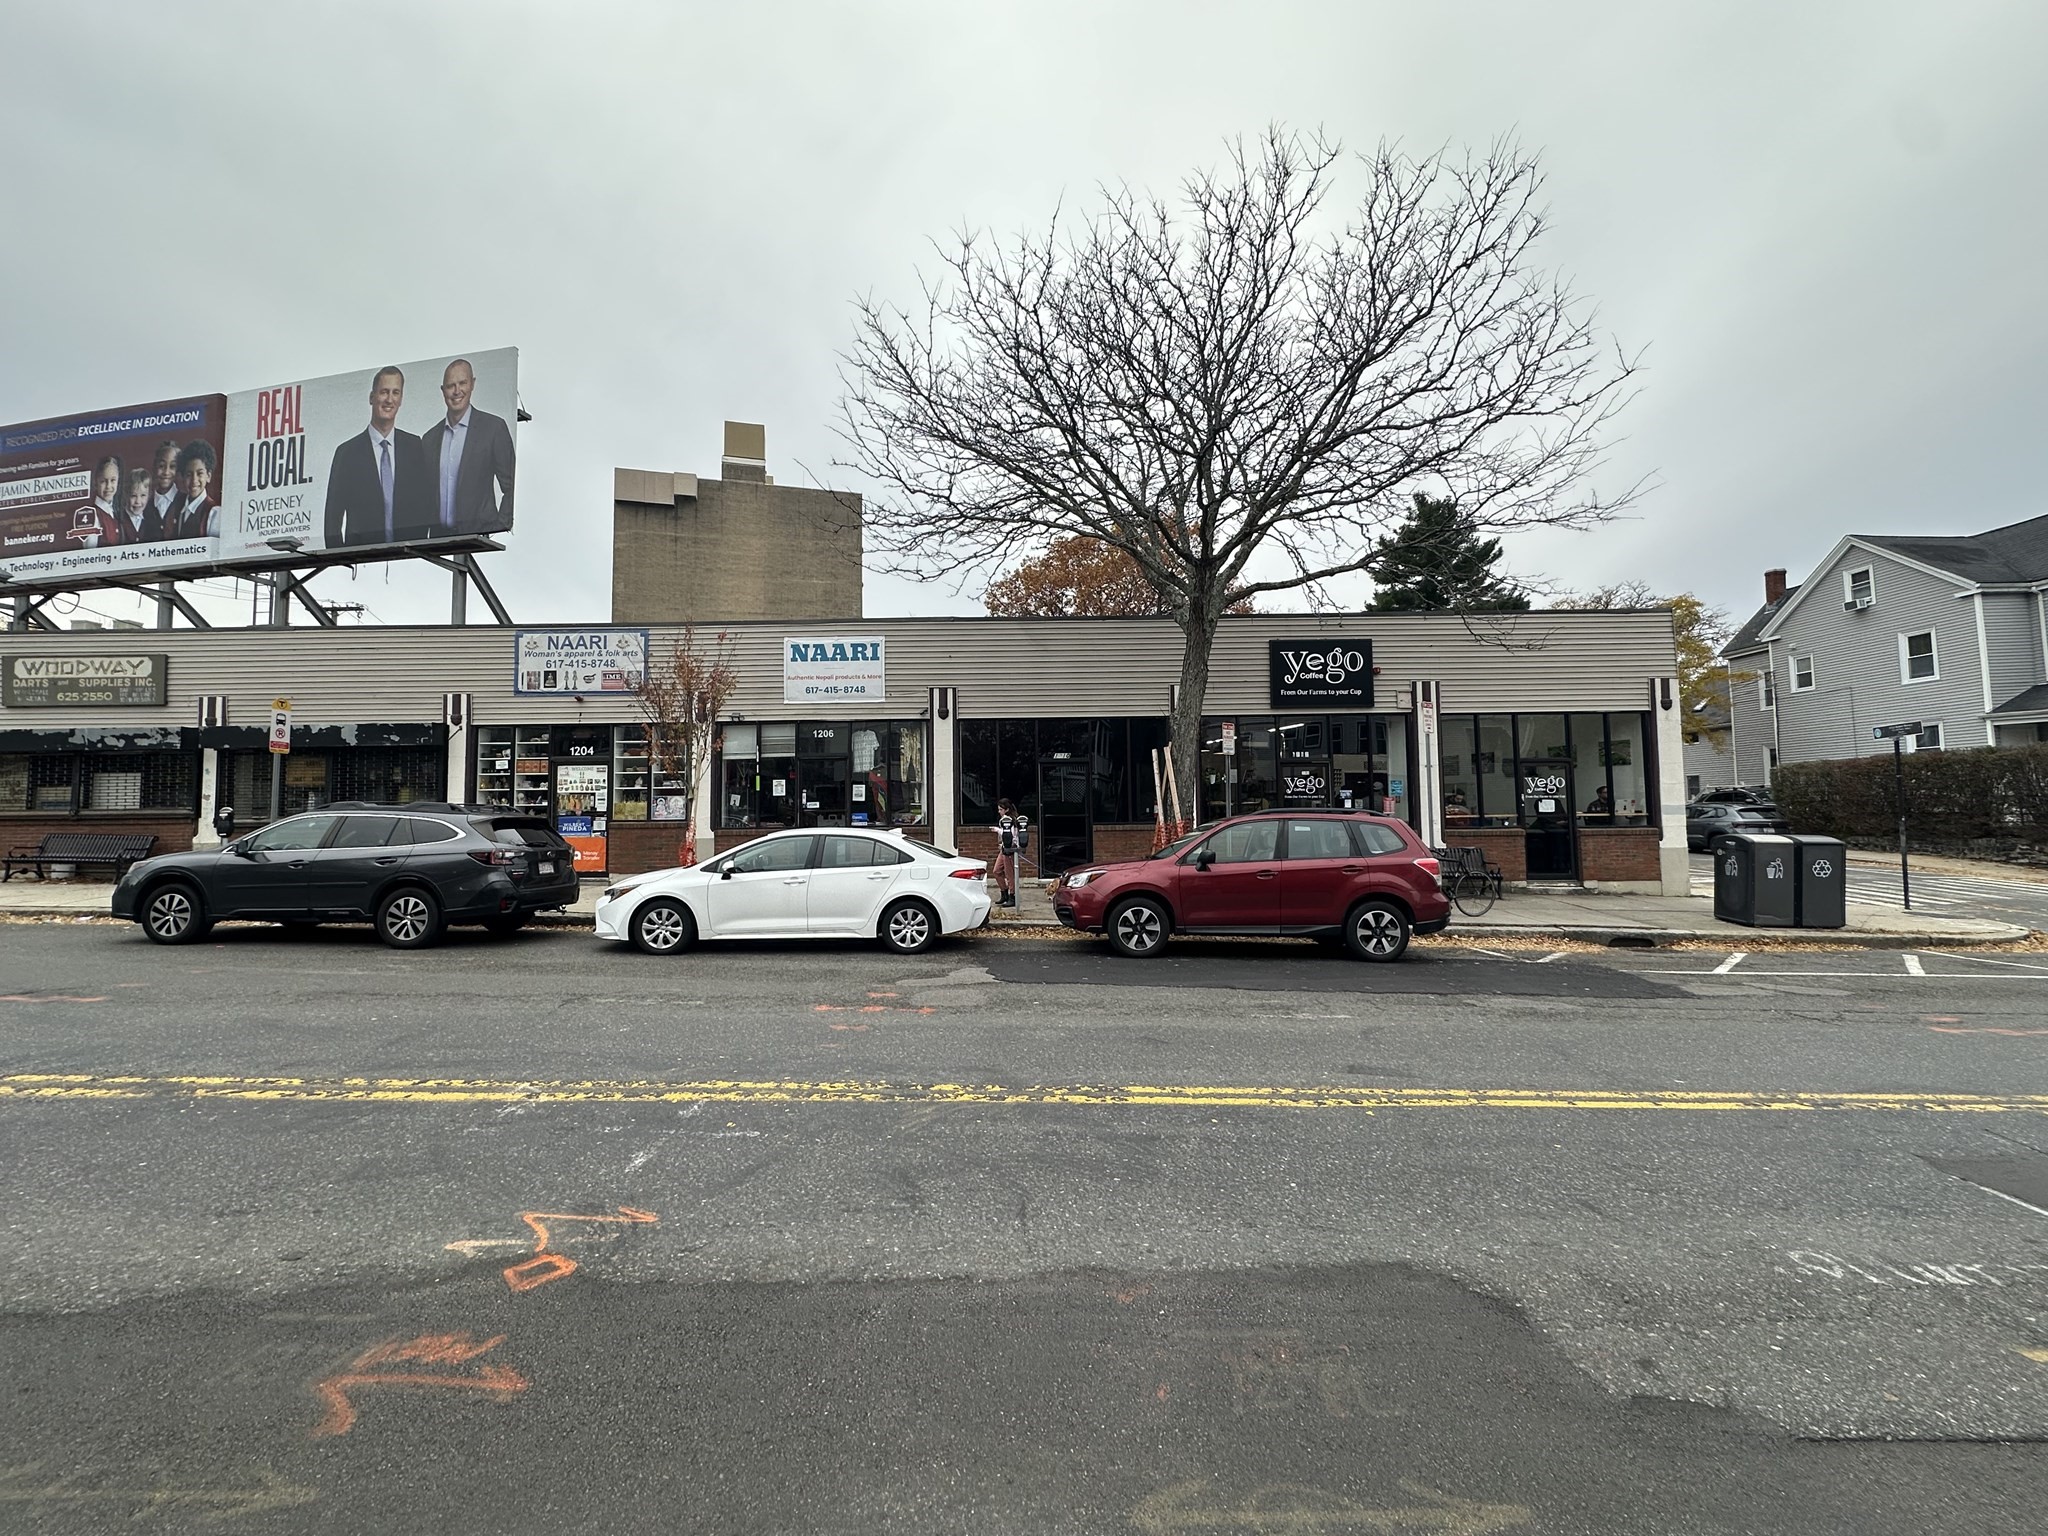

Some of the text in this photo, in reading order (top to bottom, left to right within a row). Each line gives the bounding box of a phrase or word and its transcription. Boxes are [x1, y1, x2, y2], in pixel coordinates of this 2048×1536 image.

[257, 385, 304, 440] REAL
[6, 410, 200, 447] RECOGNIZED FOR EXCELLENCE IN EDUCATION
[247, 435, 313, 492] LOCAL.
[34, 475, 88, 494] BANNEKER
[52, 491, 83, 499] SCHOOL
[248, 494, 304, 515] SWEENEY
[81, 514, 88, 523] 4
[246, 510, 311, 532] MERRIGAN
[259, 524, 311, 537] INJURY LAWYERS
[4, 533, 55, 546] banneker.org
[10, 545, 207, 572] Technology Engineering Arts Mathematics
[547, 635, 608, 650] NAARI
[524, 650, 562, 658] Woman's
[564, 650, 595, 659] apparel
[605, 649, 620, 657] folk
[622, 649, 639, 657] arts
[790, 643, 880, 662] NAARI
[22, 659, 145, 676] WOODWAY
[545, 659, 616, 668] 617-415-8748
[13, 679, 49, 687] DARTS
[79, 678, 131, 688] SUPPLIES
[134, 677, 156, 687] INC.
[816, 674, 834, 682] Nepali
[835, 674, 860, 682] products
[805, 686, 866, 694] 617-415-8748
[1336, 689, 1349, 697] your
[1350, 688, 1362, 696] Cup
[812, 730, 834, 738] 1206
[569, 746, 594, 755] 1204
